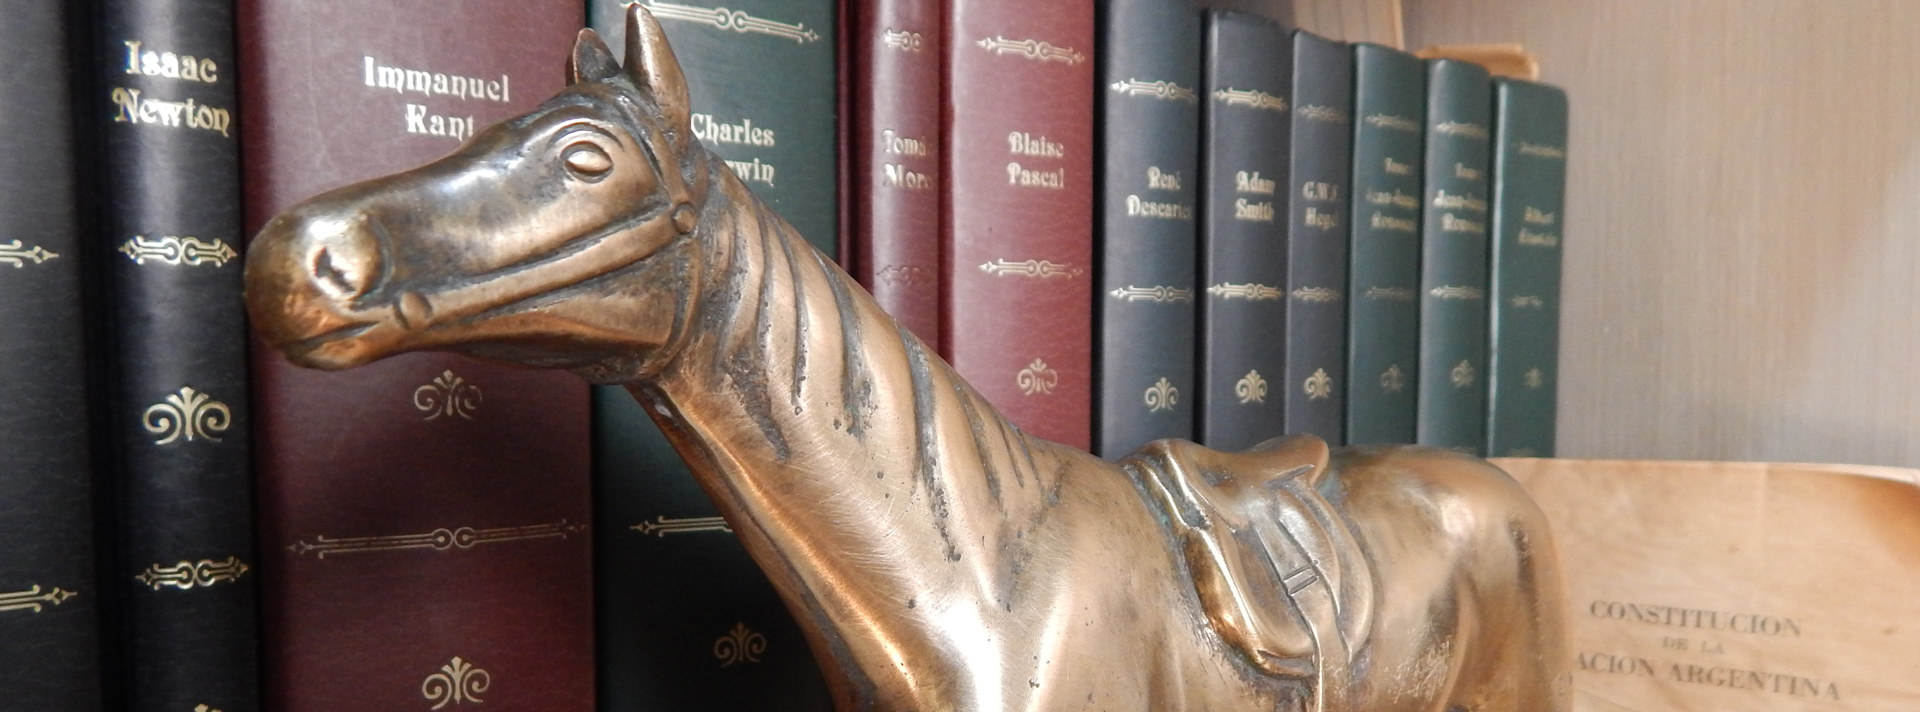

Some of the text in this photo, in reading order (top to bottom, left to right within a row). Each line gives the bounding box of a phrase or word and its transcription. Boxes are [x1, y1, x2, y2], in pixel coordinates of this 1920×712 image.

[124, 40, 218, 83] Isaac
[364, 56, 510, 102] Immanuel
[111, 86, 230, 138] Newton
[405, 103, 475, 142] Kant
[690, 112, 776, 147] Charles
[882, 129, 932, 158] Tomá
[1007, 131, 1064, 159] Blaise
[1006, 161, 1065, 190] Pascal
[1235, 170, 1276, 194] Adam
[1234, 197, 1275, 221] Smith
[1589, 600, 1801, 637] CONSTITUCION
[1662, 636, 1725, 655] DE LA
[1670, 663, 1840, 701] ARGENTINA
